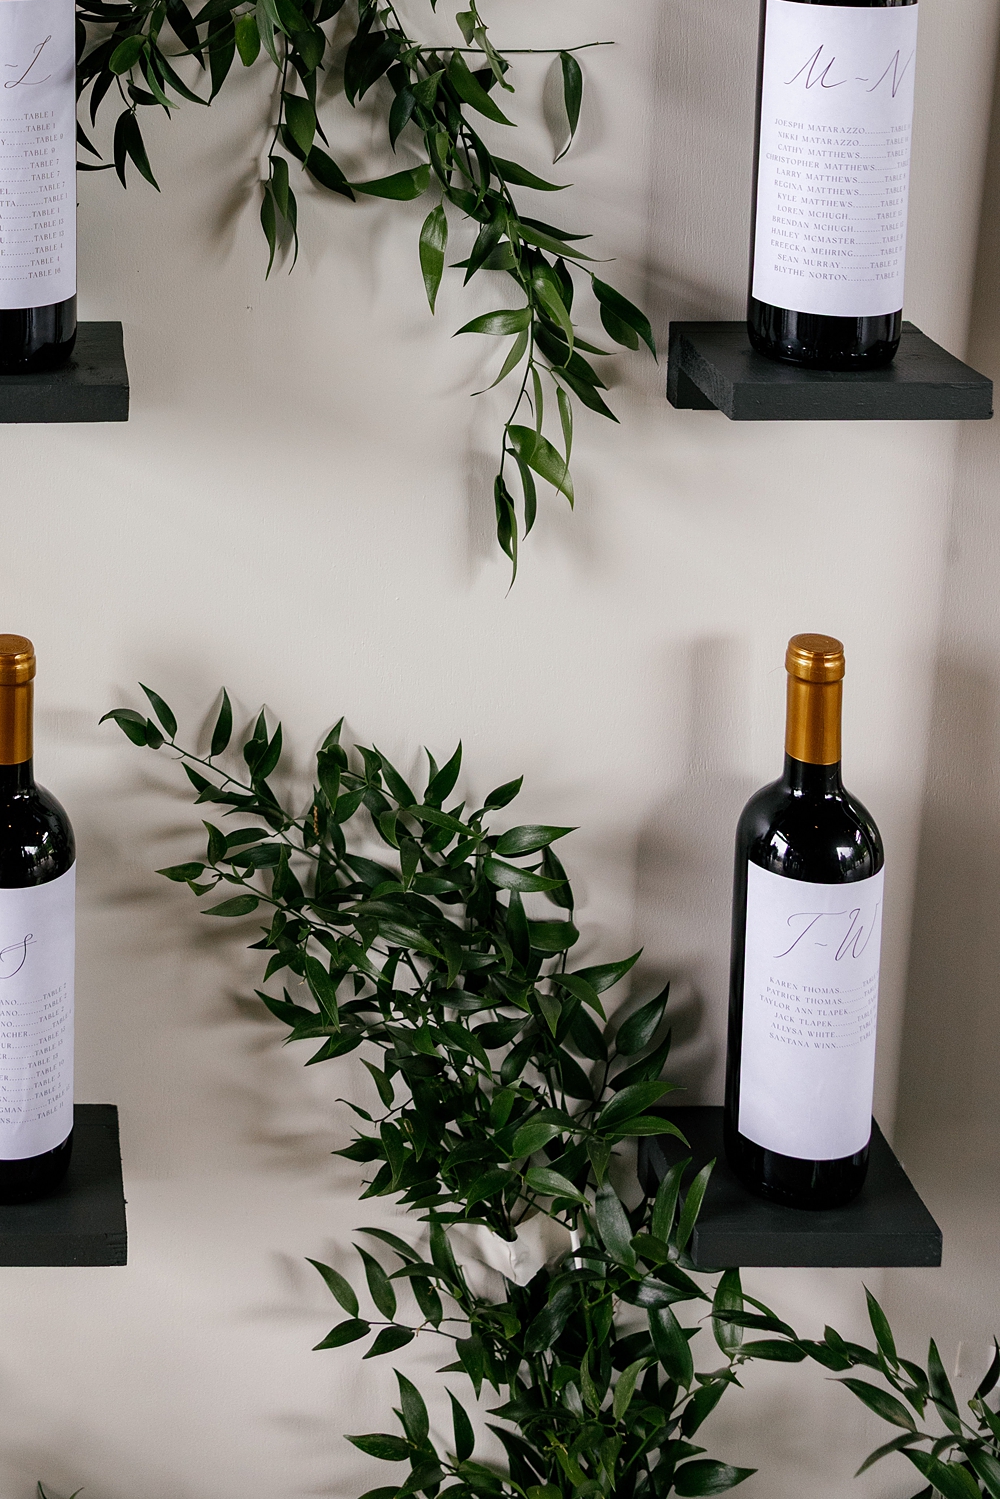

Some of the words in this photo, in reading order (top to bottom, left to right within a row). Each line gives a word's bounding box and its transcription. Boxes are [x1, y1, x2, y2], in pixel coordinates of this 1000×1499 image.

[865, 49, 914, 98] N
[24, 111, 49, 120] TABLE
[778, 131, 798, 141] NIKKI
[802, 135, 859, 146] MATARAZZO
[886, 137, 904, 145] TABLE
[30, 159, 53, 169] TABLE
[776, 167, 801, 178] LARRY
[805, 173, 858, 183] MATTHEWS
[885, 173, 902, 182] TABLE
[32, 208, 55, 217] TABLE
[771, 227, 800, 239] HAILEY
[803, 234, 855, 245] MCMASTER
[882, 235, 899, 243] TABLE
[777, 254, 799, 264] SEAN
[803, 259, 841, 269] MURRAY
[870, 260, 891, 269] TABLE
[28, 269, 52, 279] TABLE
[774, 264, 805, 277] BLYTHE
[809, 271, 848, 280] NORTON
[773, 910, 847, 959] T
[835, 902, 879, 961] W
[42, 985, 62, 1000] TABLE
[769, 976, 798, 990] KAREN
[802, 985, 840, 994] THOMAS
[766, 986, 801, 1002] PATRICK
[805, 997, 842, 1005] THOMAS
[759, 994, 791, 1011] TAYLOR
[795, 1007, 813, 1015] ANN
[774, 1012, 795, 1023] JACK
[799, 1018, 832, 1027] TLAPEK
[770, 1022, 803, 1036] ALLYSA
[807, 1030, 835, 1038] WHITE
[769, 1032, 809, 1048] SANTANA
[28, 1057, 50, 1069] TABLE
[34, 1076, 56, 1088] TABLE
[37, 1106, 57, 1119] TABLE
